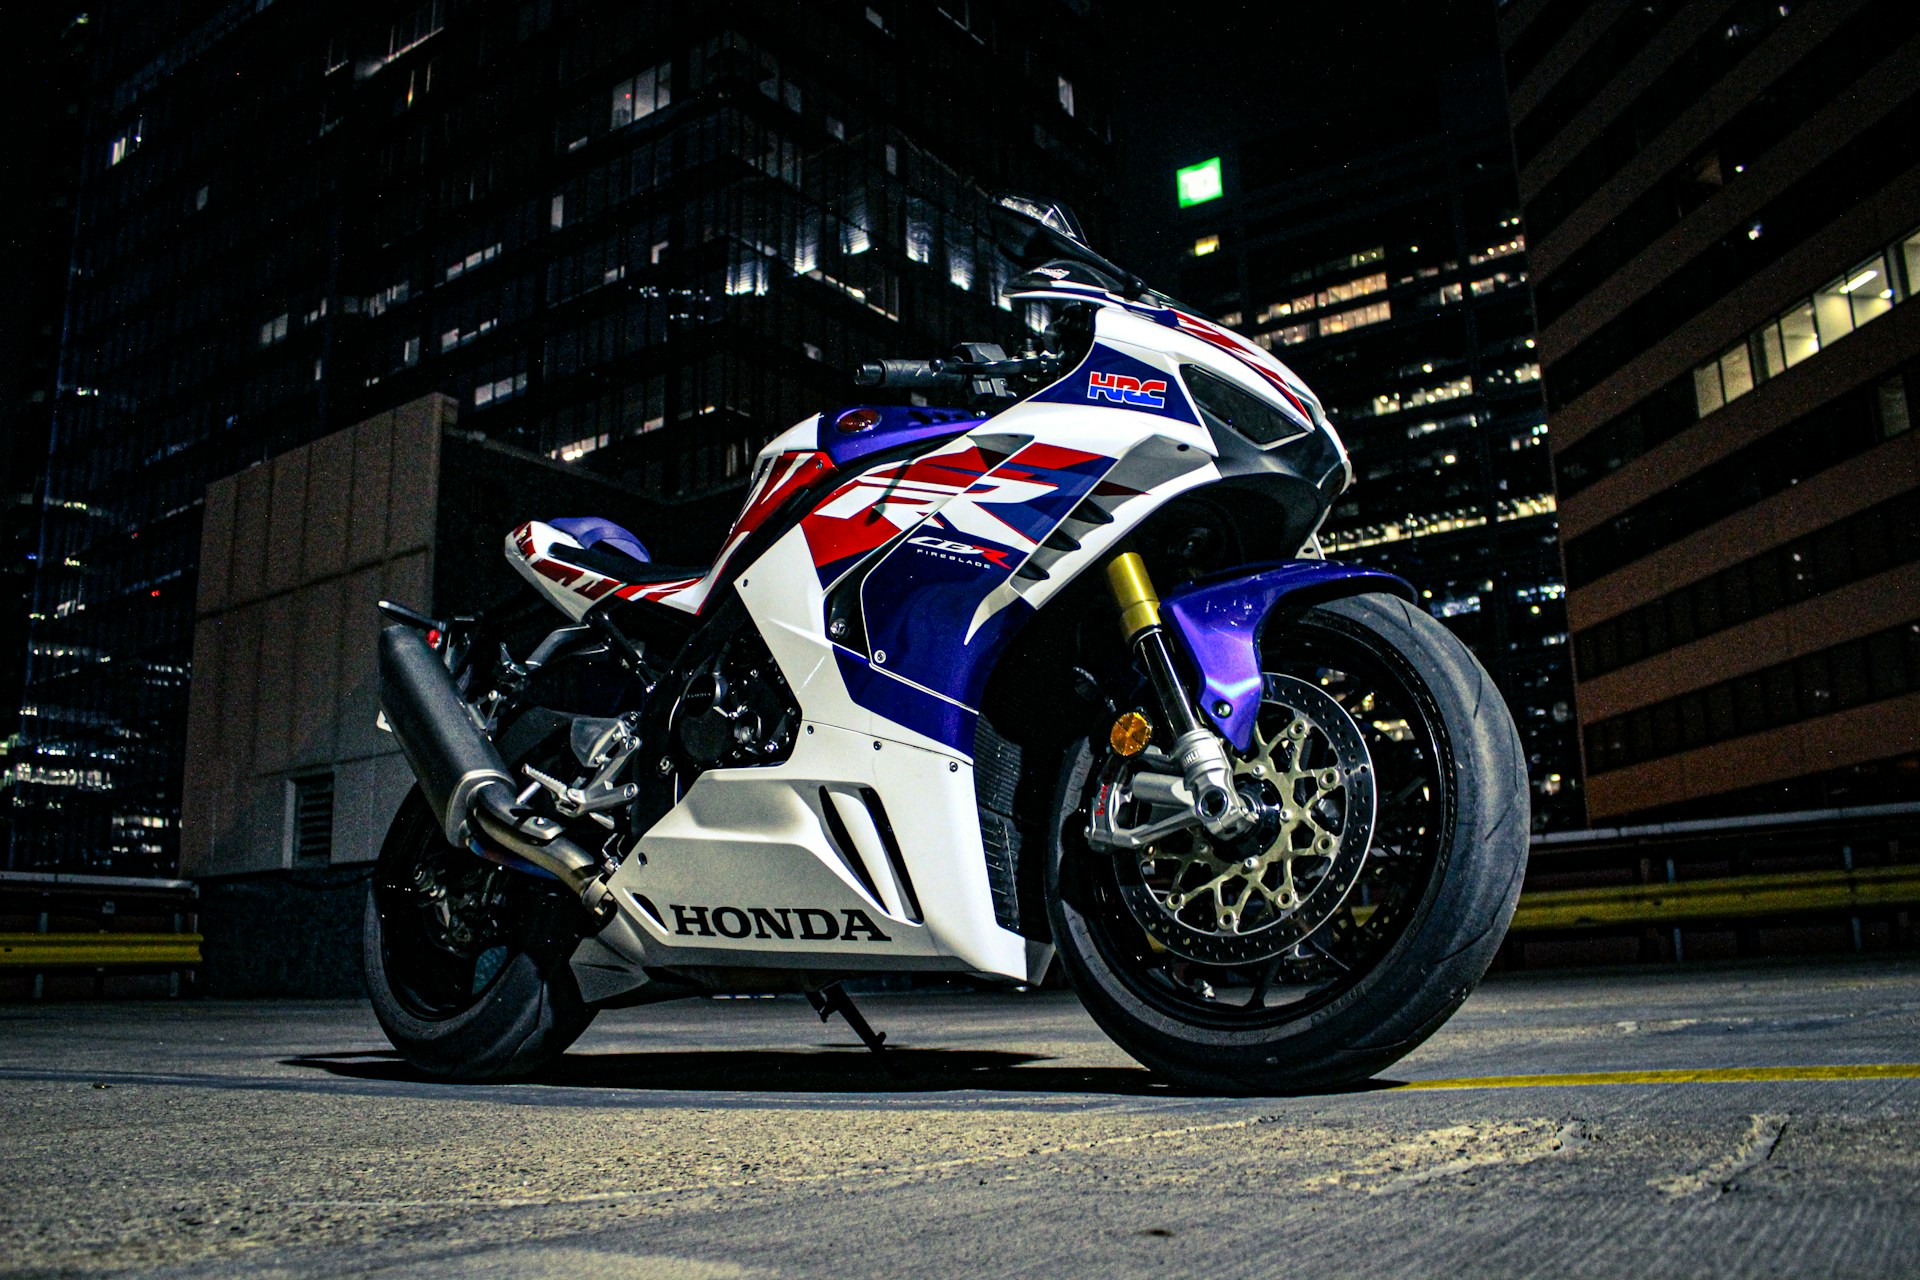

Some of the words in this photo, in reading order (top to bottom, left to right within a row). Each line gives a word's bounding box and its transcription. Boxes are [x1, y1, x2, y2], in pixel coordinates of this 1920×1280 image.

[1087, 371, 1167, 409] HRC
[907, 536, 1012, 570] CBR
[916, 549, 991, 570] FIREBLADE
[669, 904, 892, 942] HONDA
